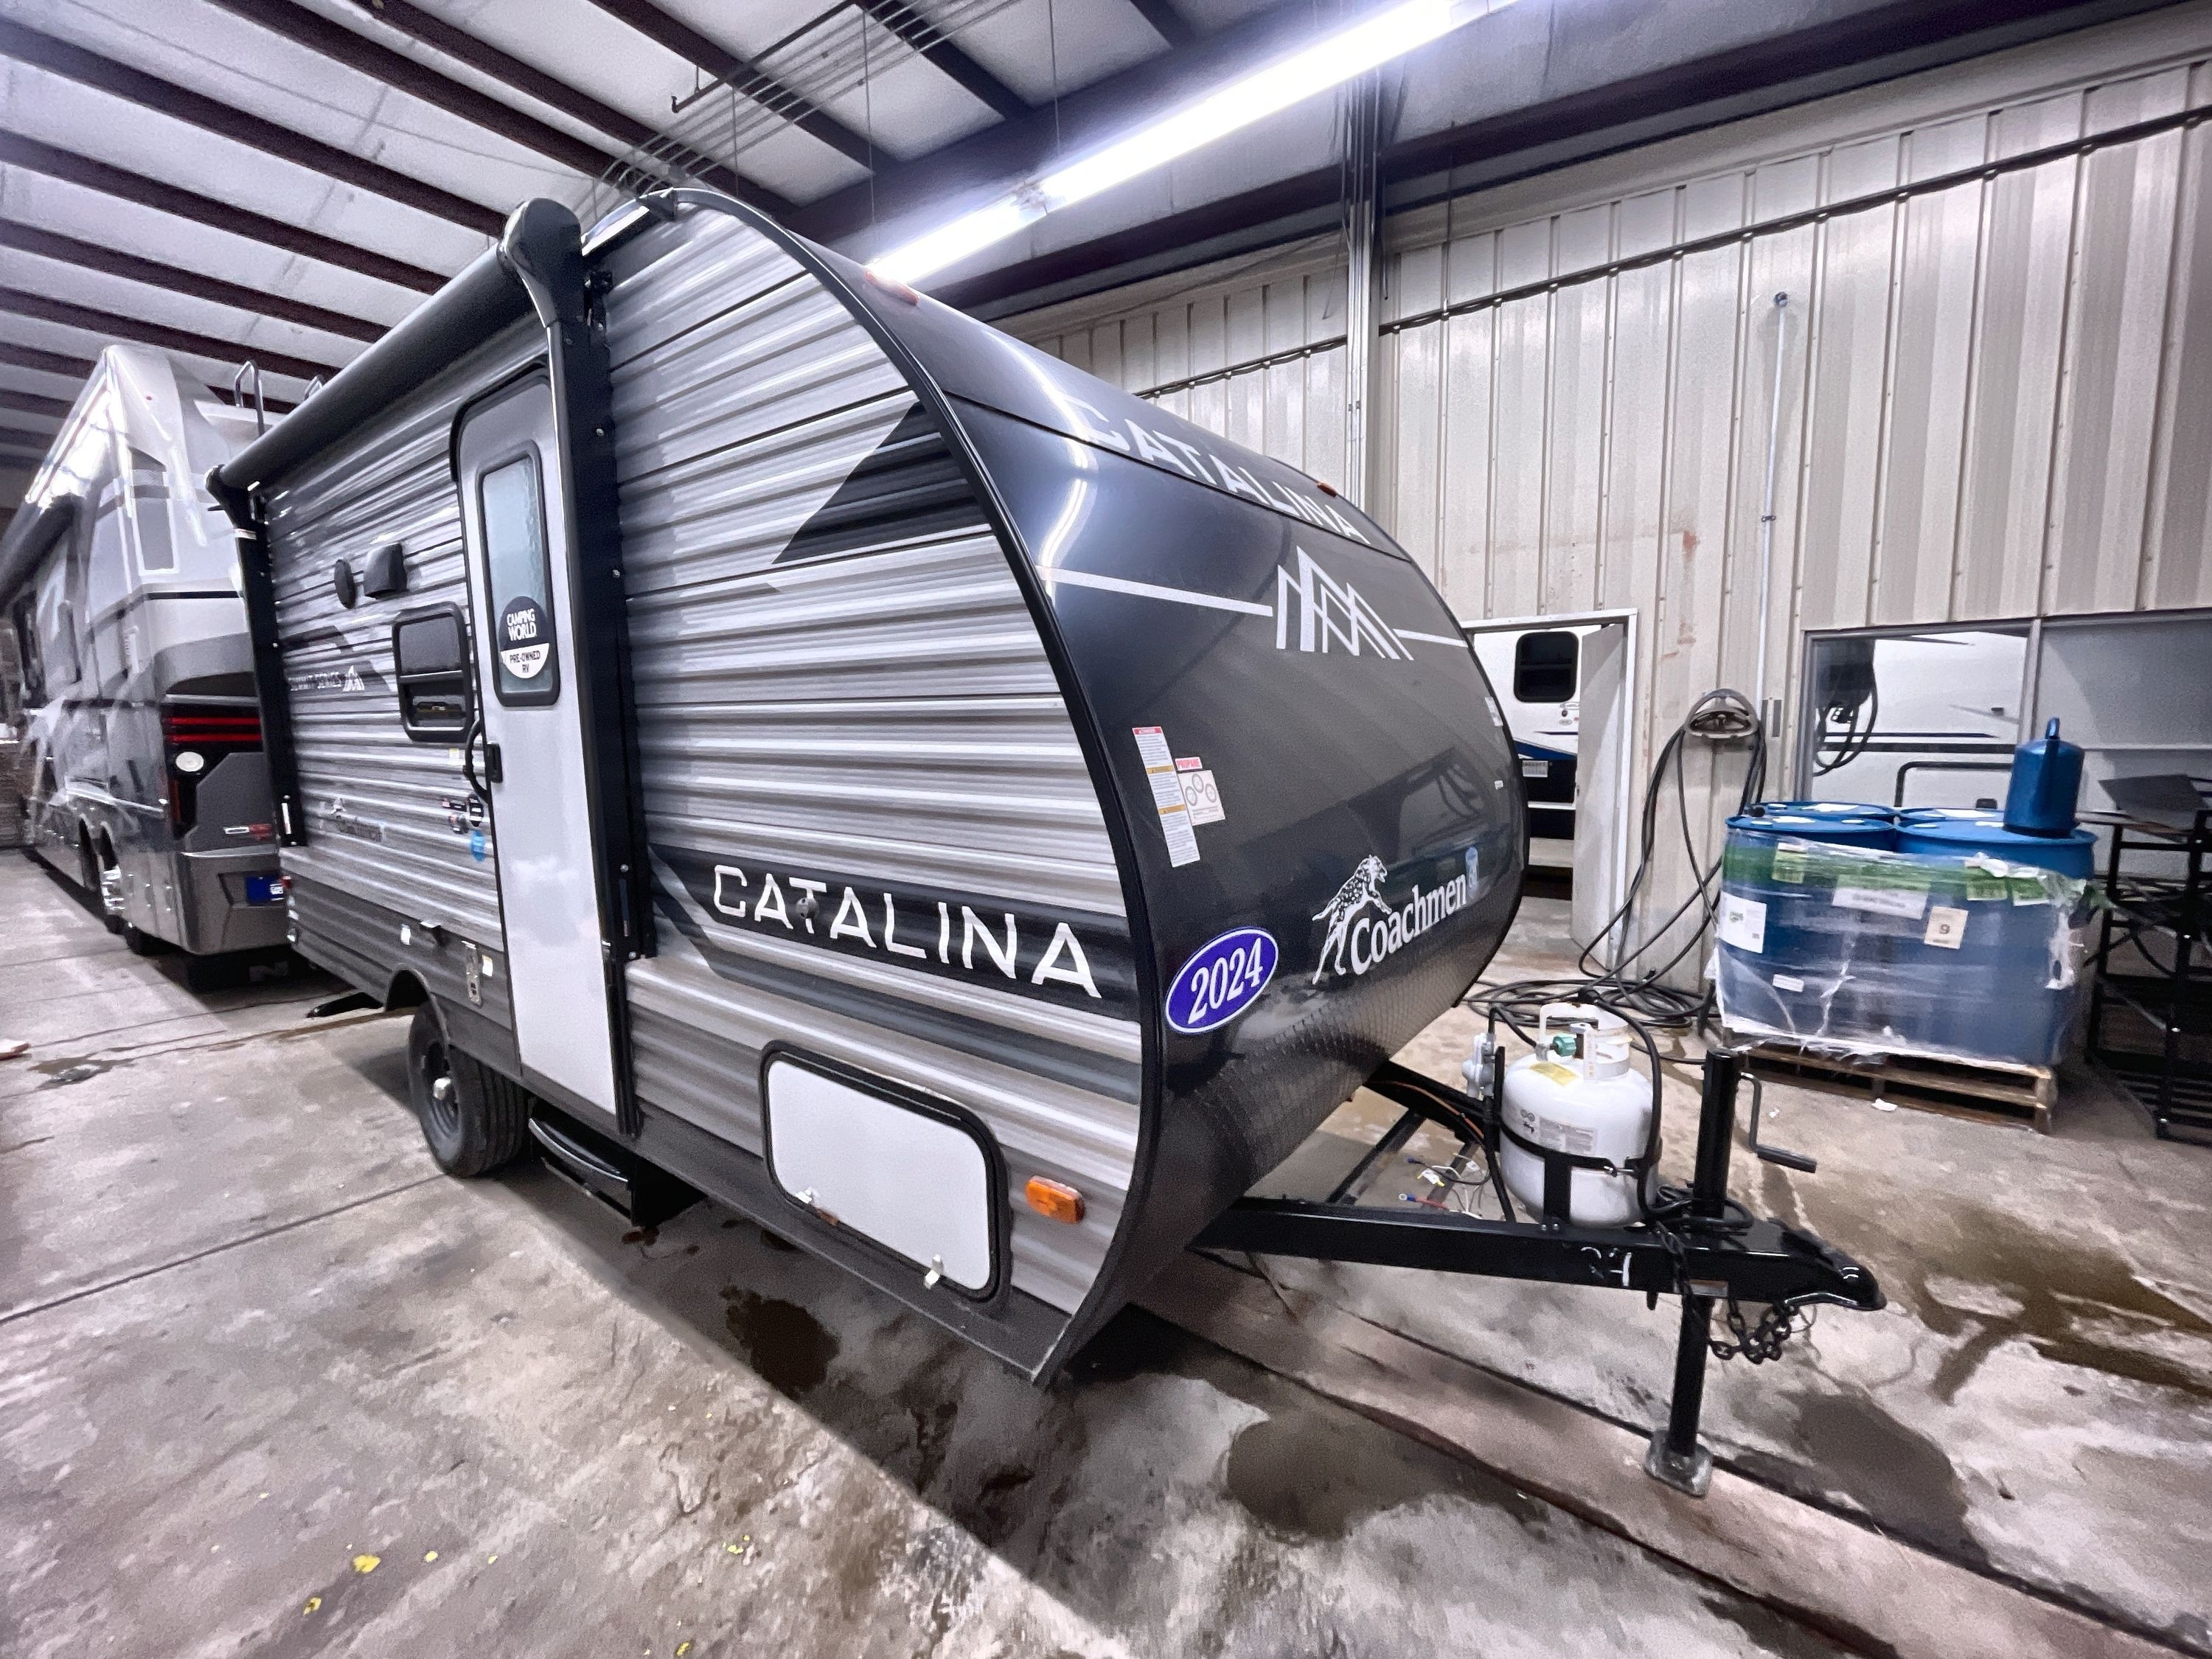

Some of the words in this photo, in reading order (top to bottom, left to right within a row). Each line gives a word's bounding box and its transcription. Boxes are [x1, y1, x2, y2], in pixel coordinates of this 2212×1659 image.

[1062, 392, 1371, 545] CATALINA
[506, 608, 536, 627] CAMPING
[507, 622, 537, 641] WORLD
[509, 650, 541, 664] PRE-OWNED
[521, 663, 530, 673] RV
[1176, 759, 1200, 770] PROPANE
[713, 864, 1103, 999] CATALINA
[1350, 874, 1467, 975] Coachmen
[1938, 923, 1951, 935] 9
[1187, 937, 1263, 1025] 2024
